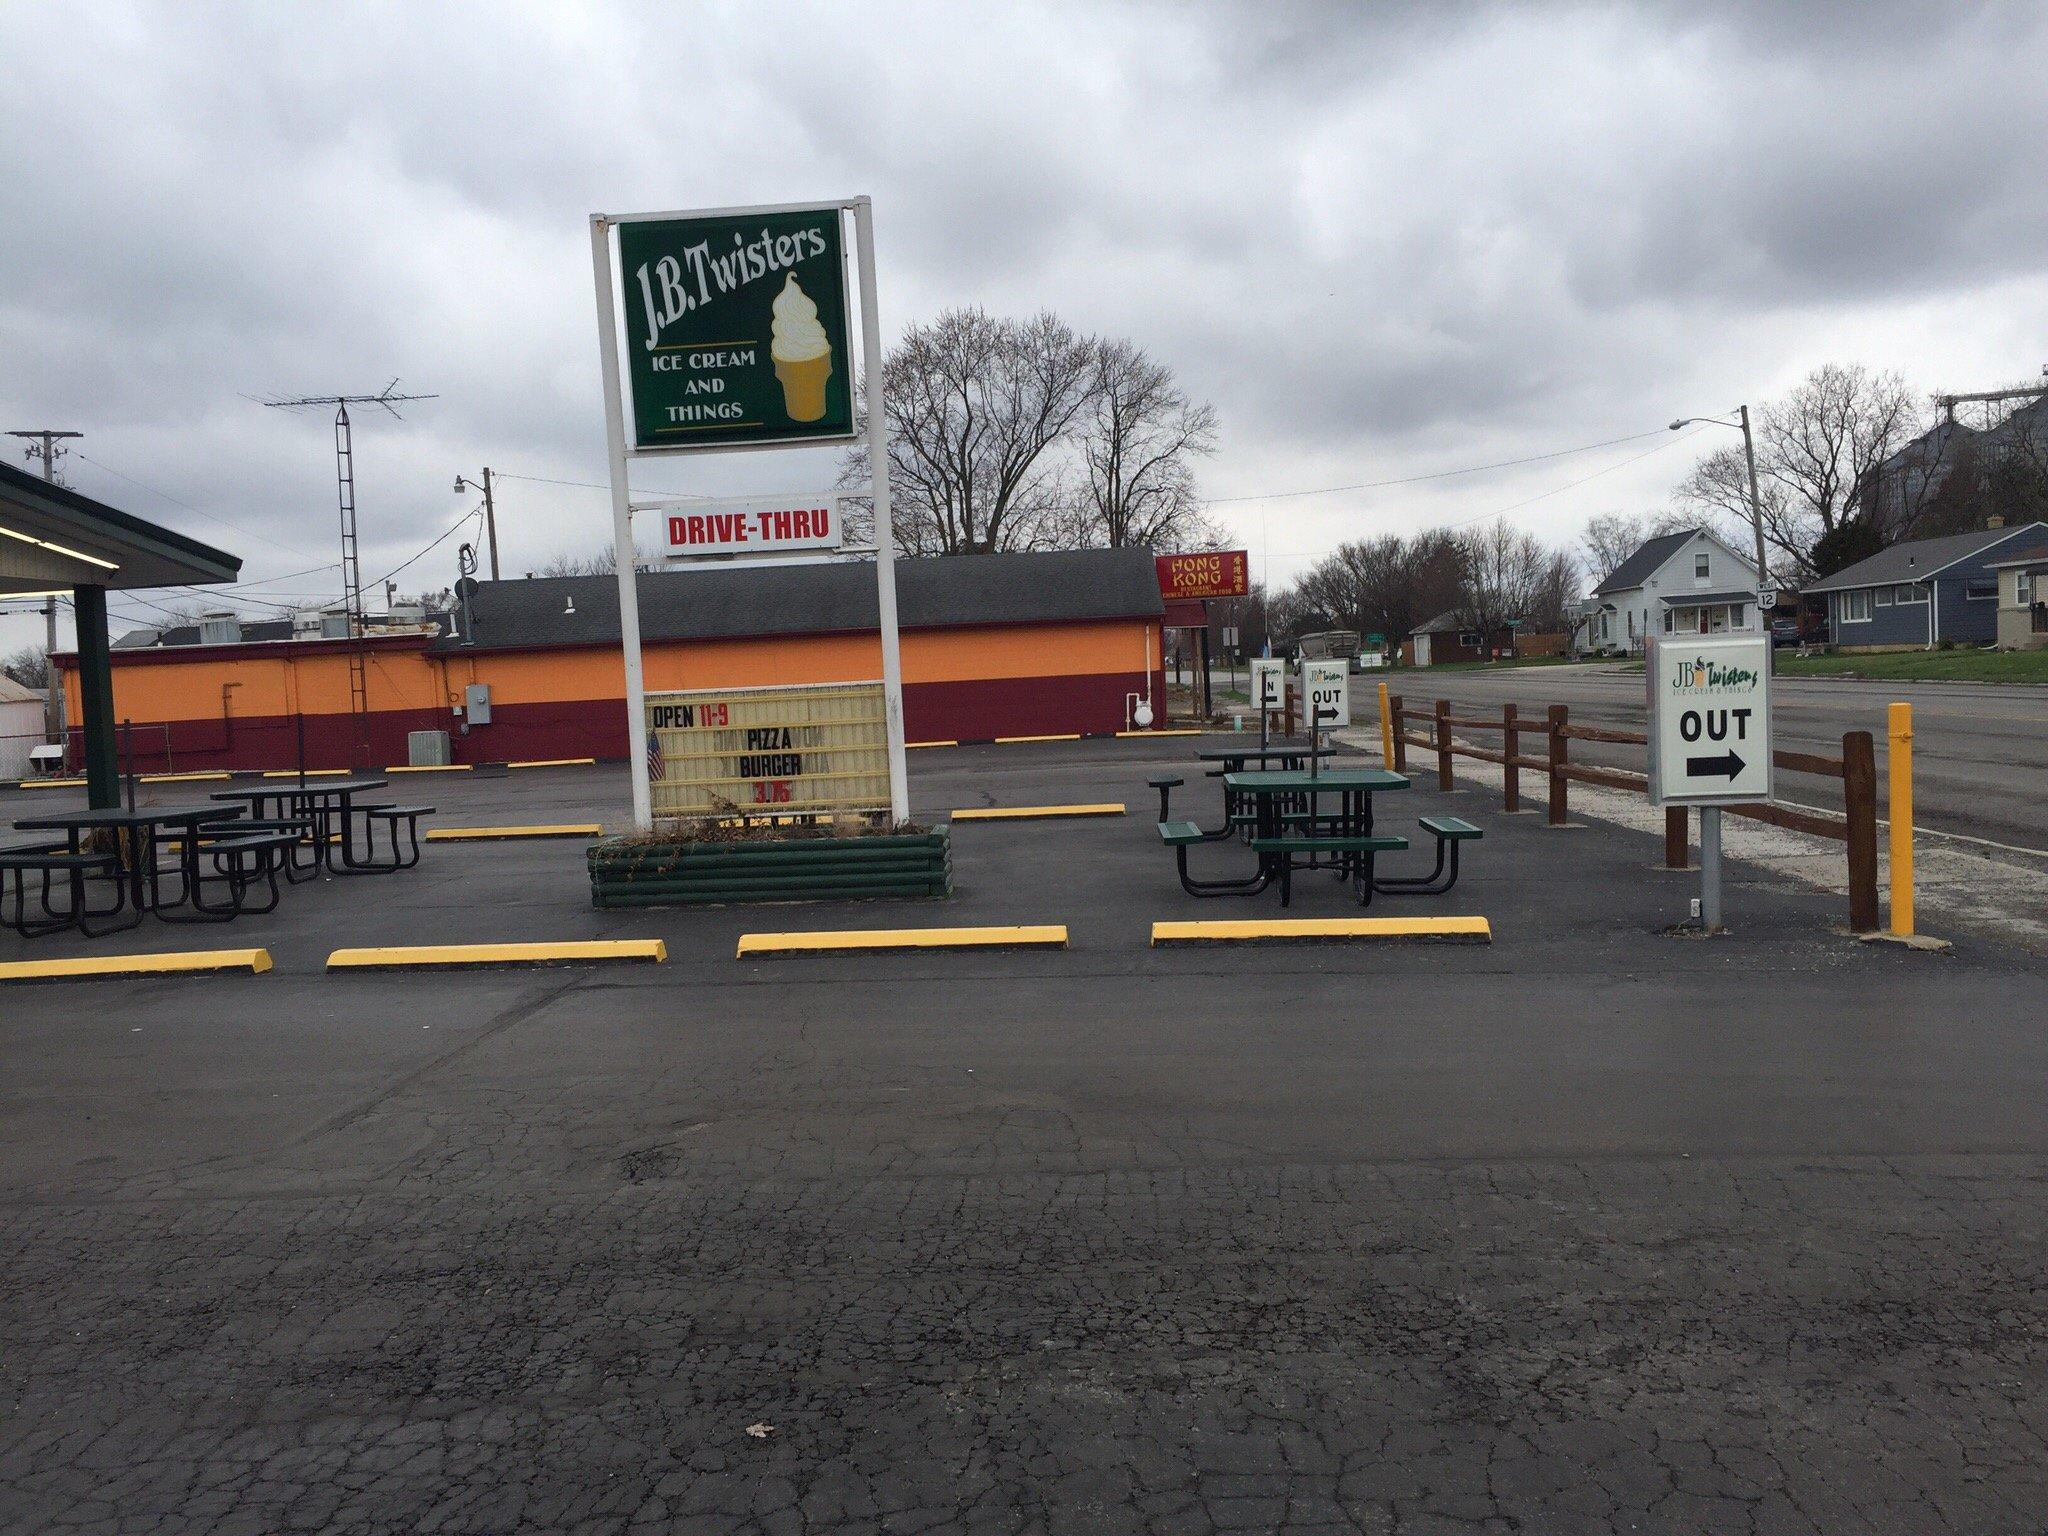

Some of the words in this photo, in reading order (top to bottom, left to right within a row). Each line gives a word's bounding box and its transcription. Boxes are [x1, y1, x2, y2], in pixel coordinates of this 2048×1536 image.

[652, 354, 682, 372] ICE
[689, 350, 756, 369] CREAM
[685, 378, 725, 395] AND
[665, 402, 744, 422] THINGS
[668, 509, 829, 546] DRIVE-THRU
[1171, 556, 1220, 573] HONG
[1173, 571, 1221, 587] KONG
[1762, 594, 1774, 605] 12
[1672, 661, 1695, 688] JB
[1706, 661, 1758, 688] Twisters
[1312, 690, 1341, 704] OUT
[653, 705, 694, 728] OPEN
[700, 703, 729, 727] 11-9
[1680, 708, 1752, 742] OUT
[747, 727, 792, 750] PIZZA
[740, 754, 800, 778] BURGER
